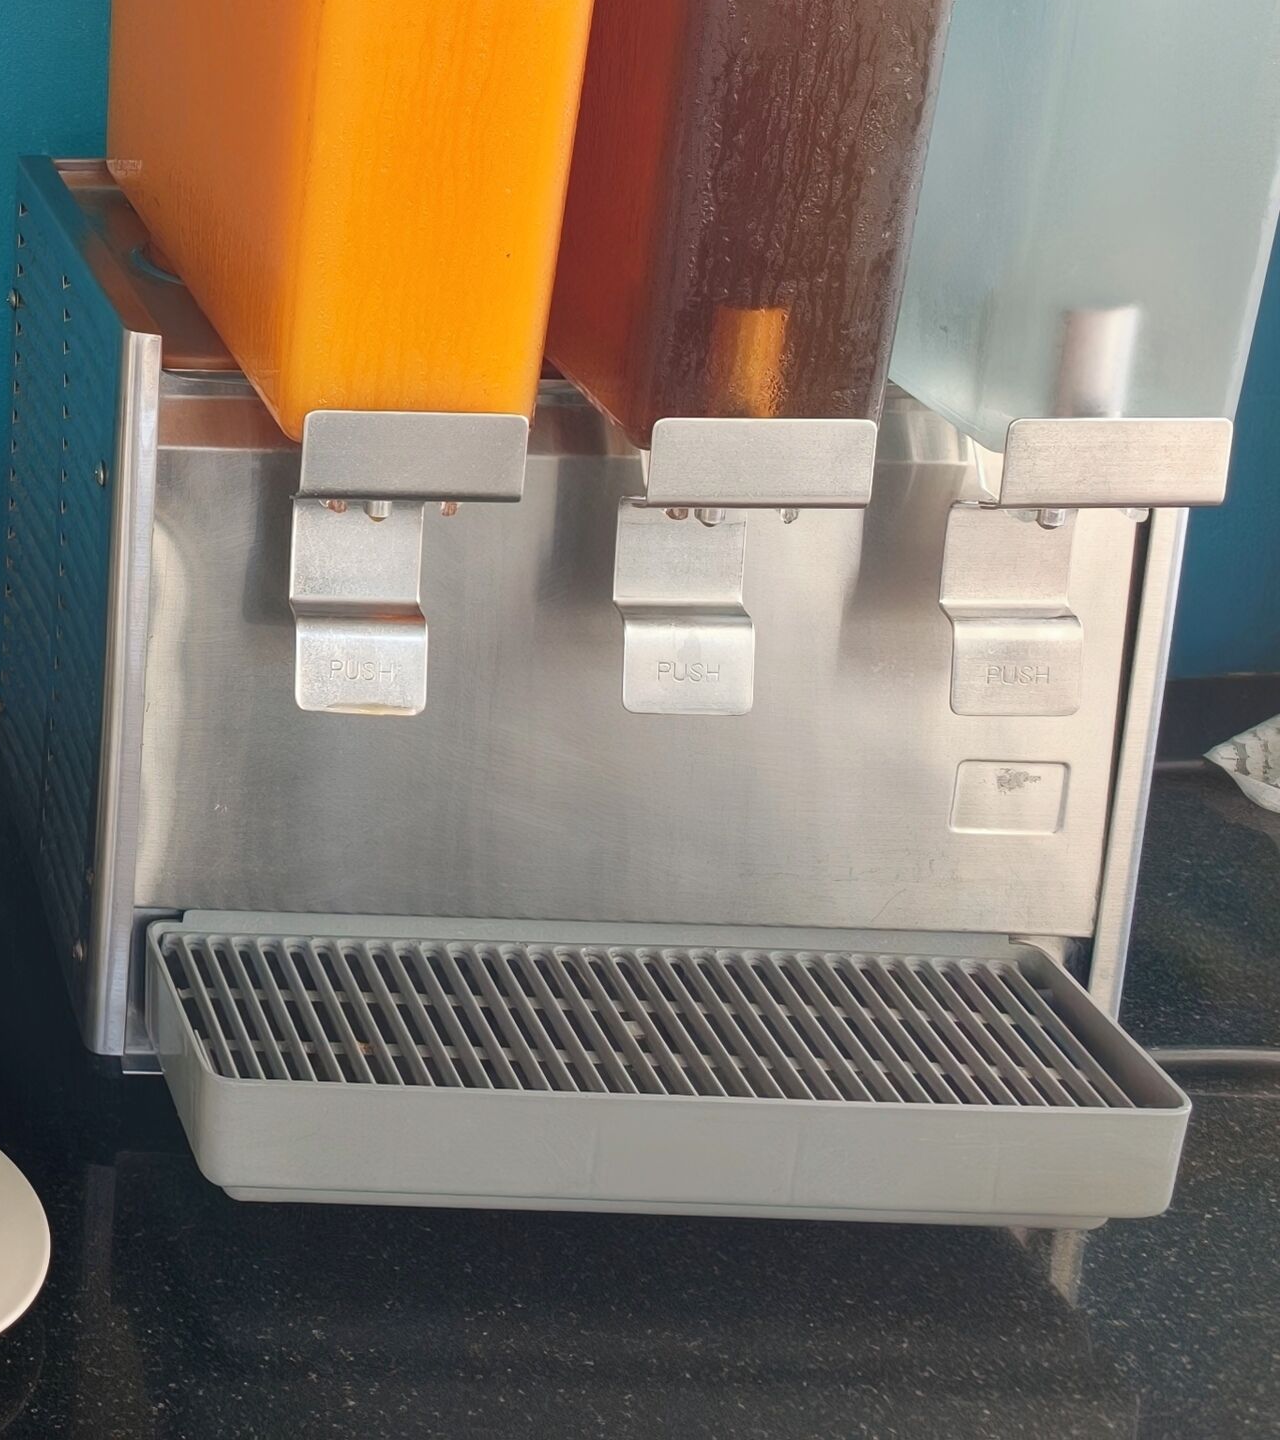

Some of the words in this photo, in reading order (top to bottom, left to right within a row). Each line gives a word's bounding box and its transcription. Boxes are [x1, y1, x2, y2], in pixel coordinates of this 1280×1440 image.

[329, 659, 394, 682] PUSH
[657, 661, 721, 683] PUSH
[986, 664, 1051, 686] PUSH
